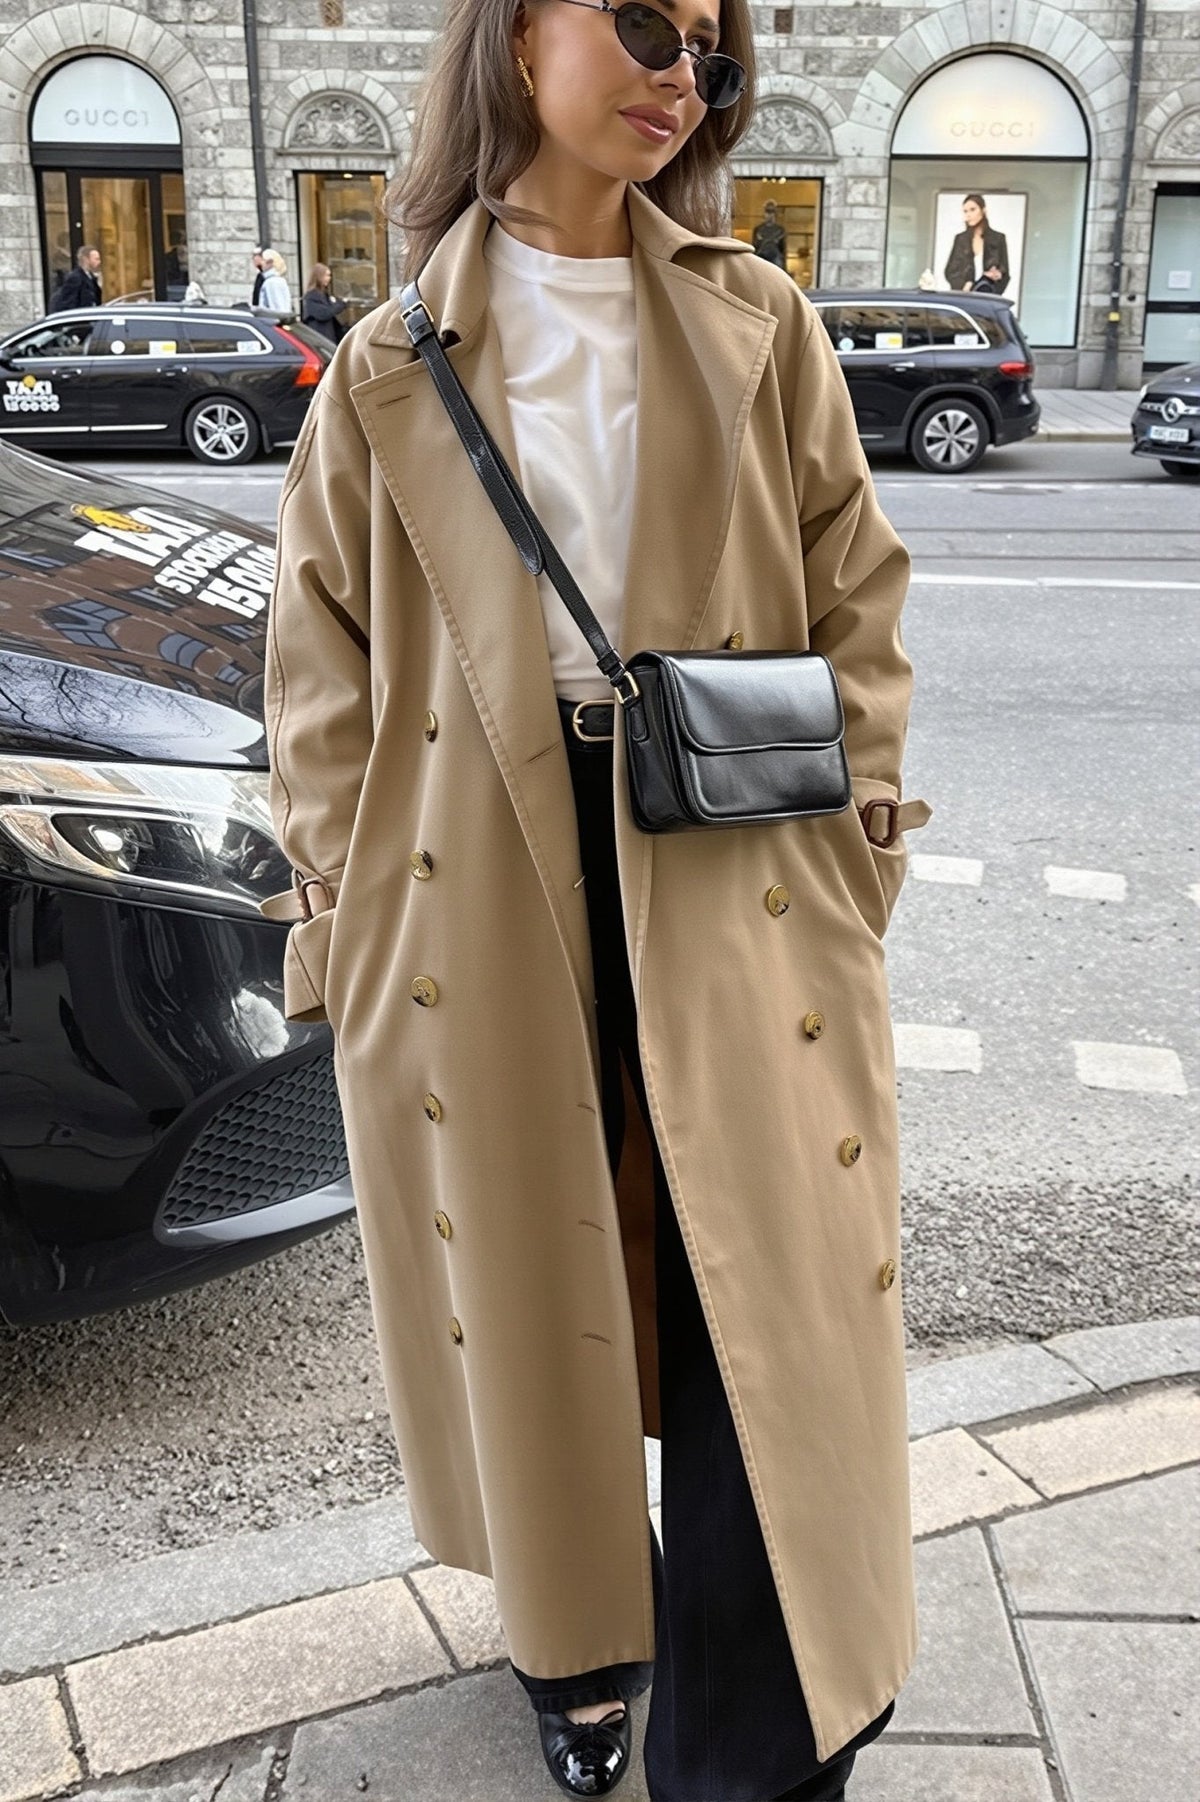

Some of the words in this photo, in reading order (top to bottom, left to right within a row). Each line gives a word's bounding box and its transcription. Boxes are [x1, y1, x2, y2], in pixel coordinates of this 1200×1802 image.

[64, 108, 149, 127] GUCCI
[950, 120, 1034, 138] GUCCI
[5, 380, 53, 396] TAXI
